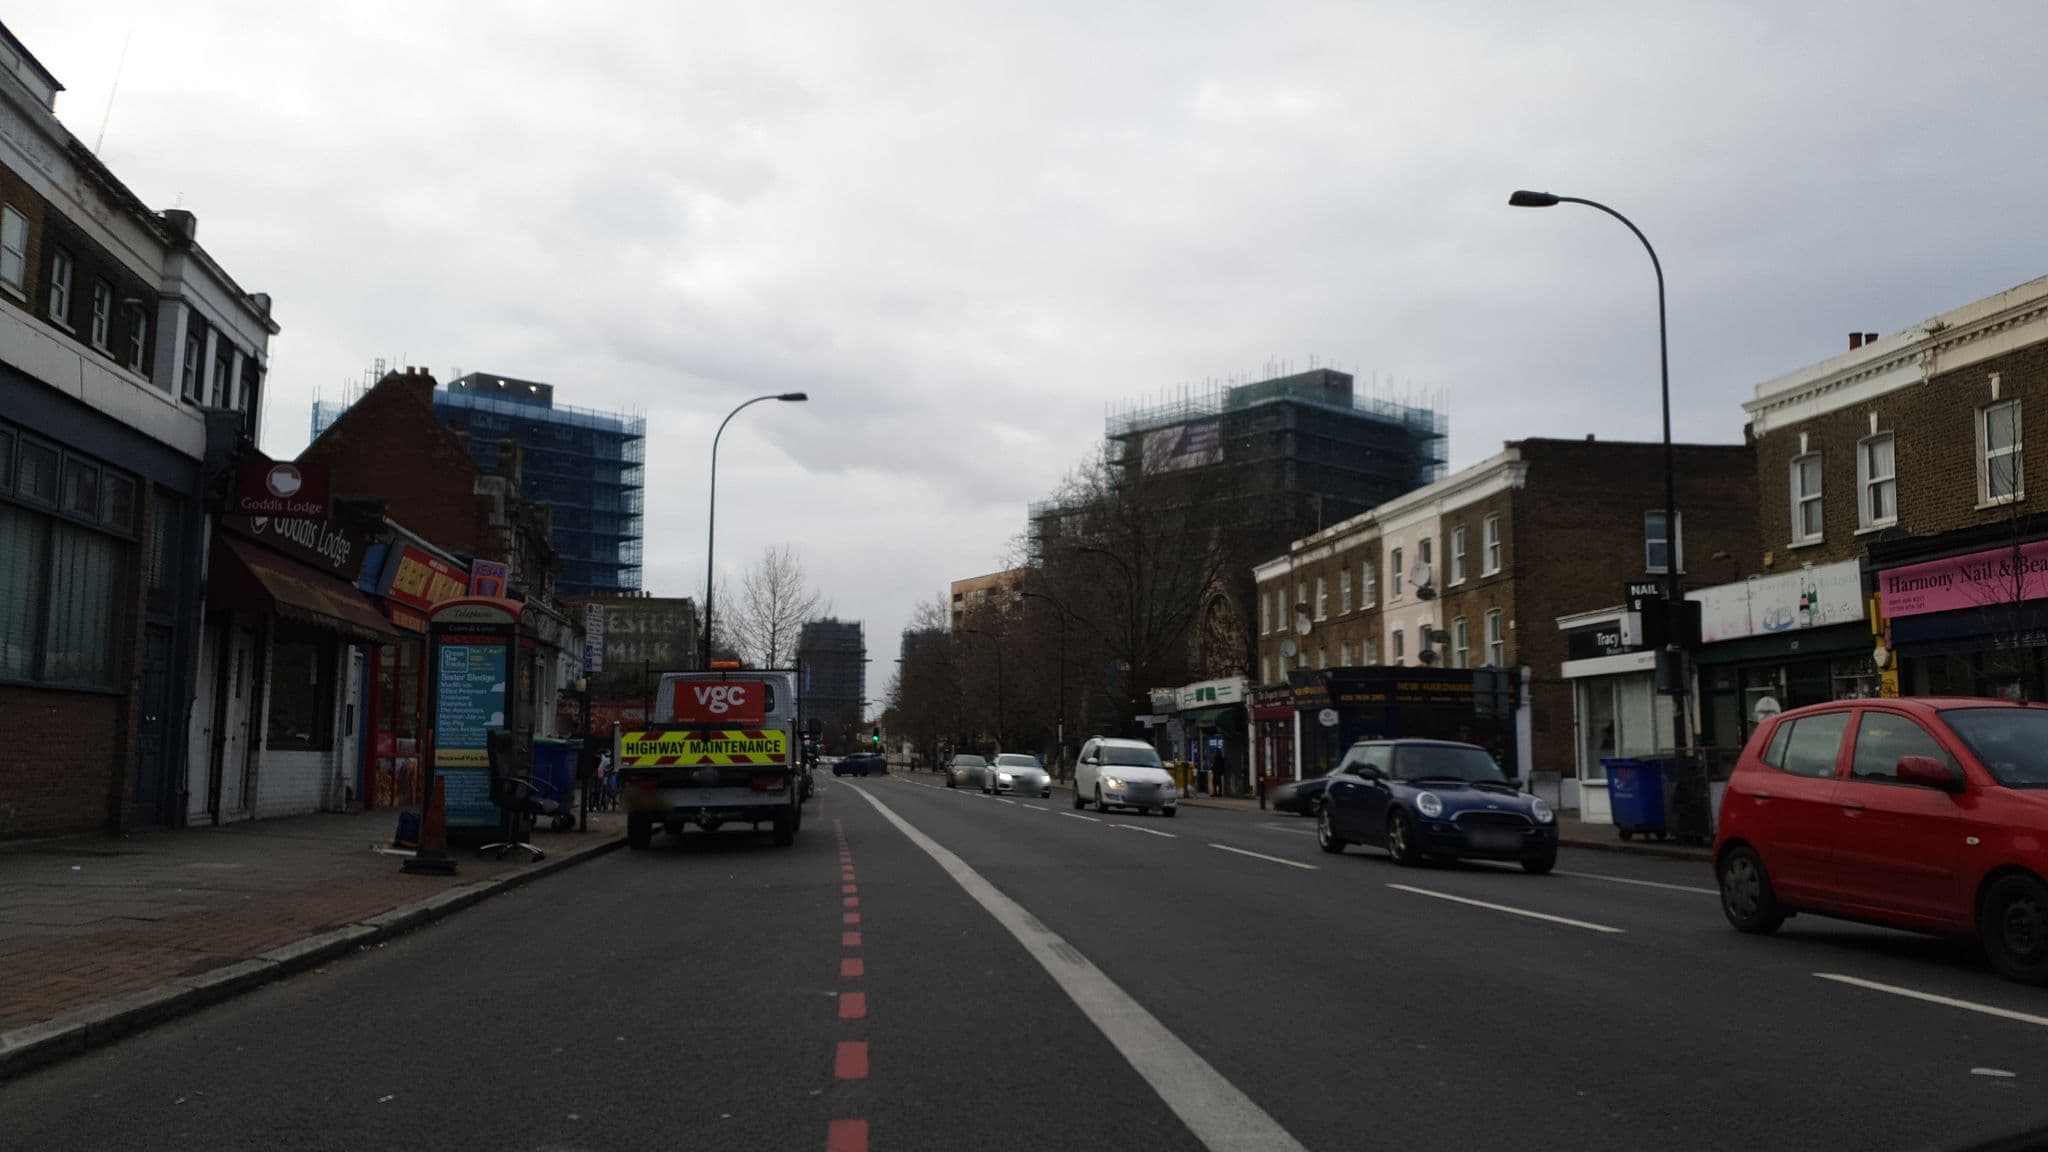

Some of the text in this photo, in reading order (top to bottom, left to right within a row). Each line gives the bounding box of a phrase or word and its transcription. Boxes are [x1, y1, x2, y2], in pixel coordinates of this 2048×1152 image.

[287, 500, 323, 516] Lodge
[317, 520, 351, 568] Lodge
[1888, 574, 1954, 595] Harmony
[1960, 561, 1992, 584] Nail
[1998, 560, 2010, 577] &
[1630, 584, 1659, 596] NAIL
[693, 685, 746, 714] vgc
[626, 739, 781, 755] HIGHWAY MAINTENANCE
